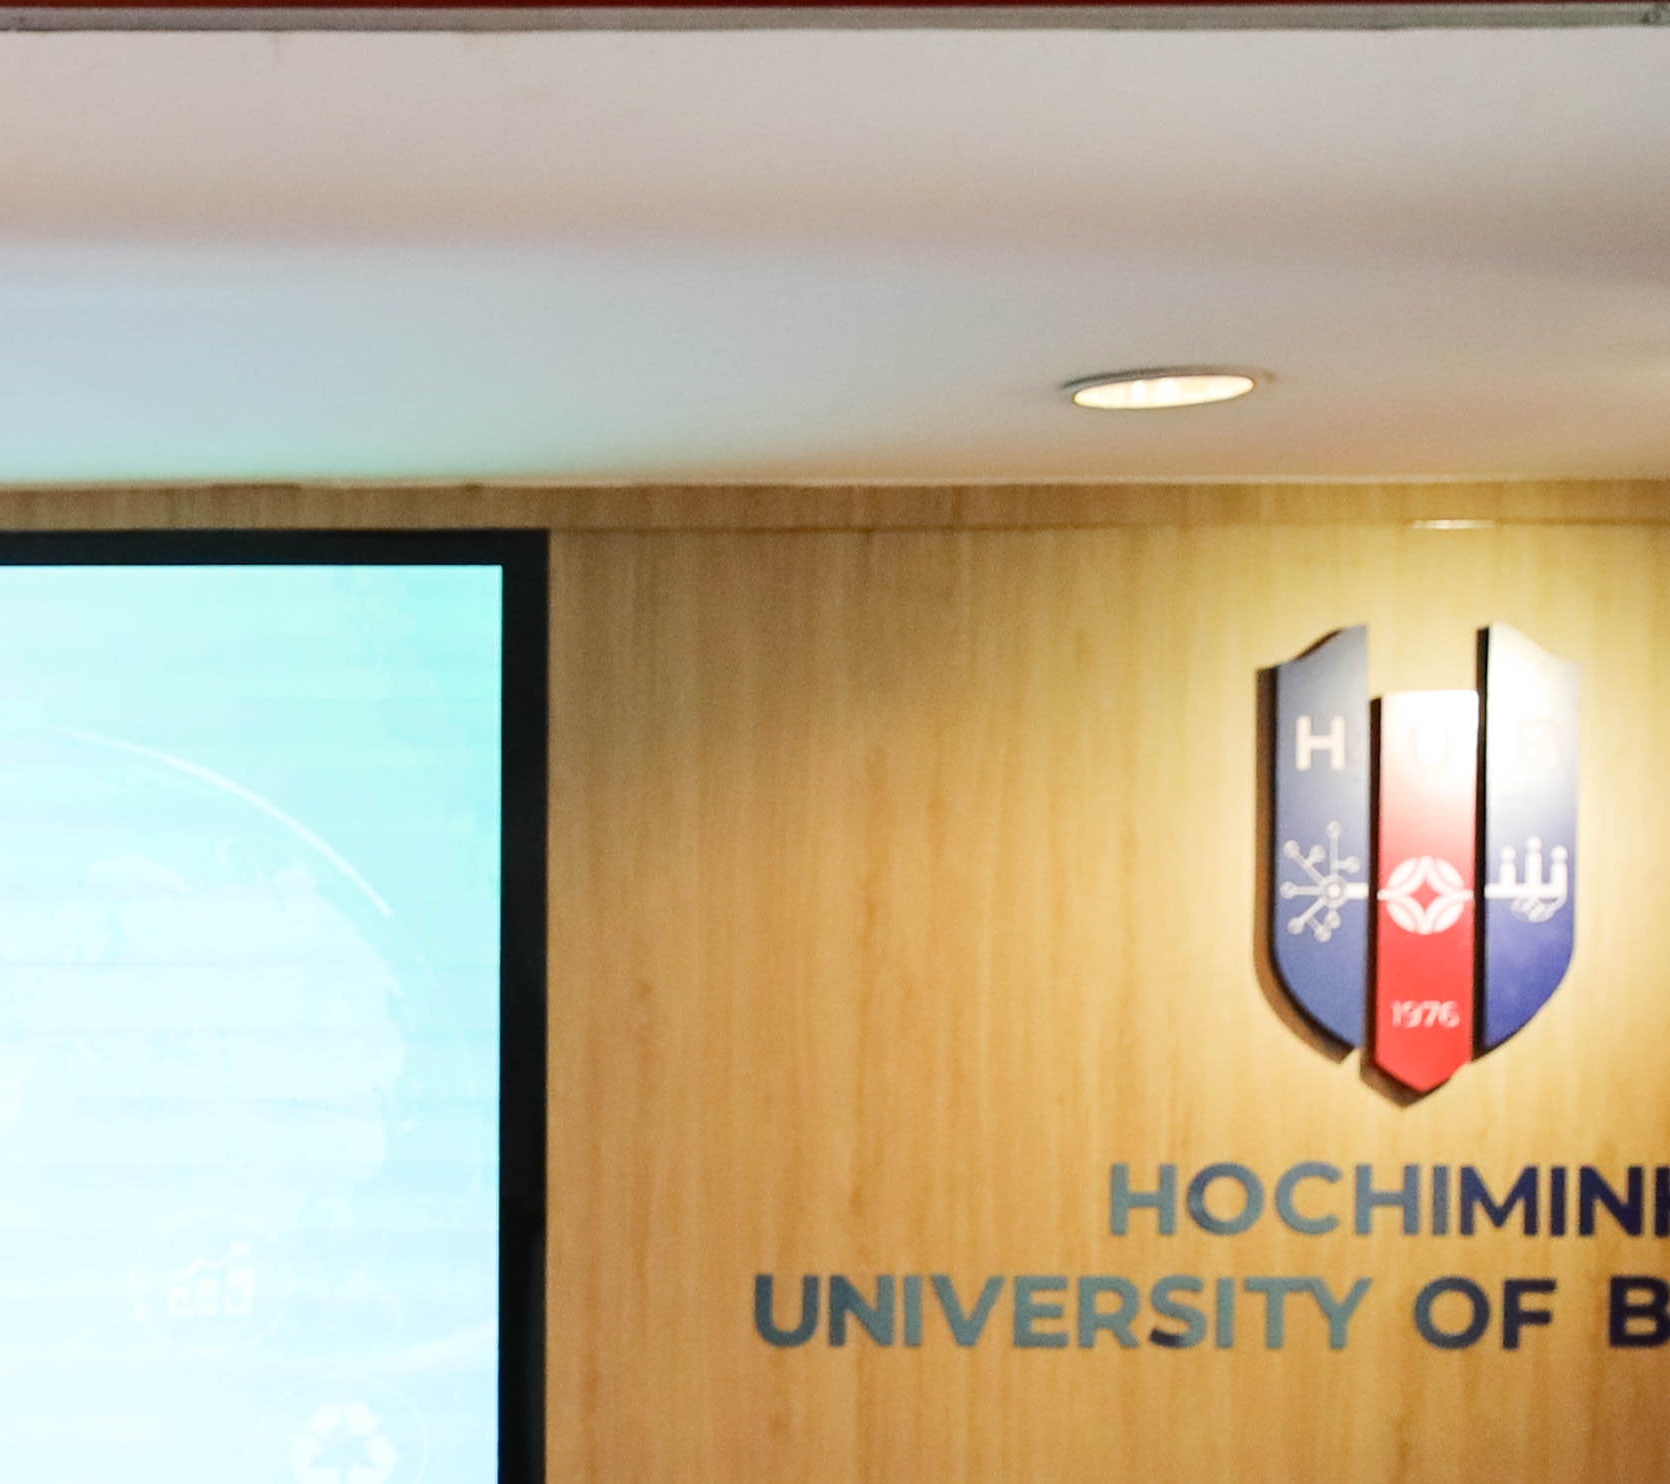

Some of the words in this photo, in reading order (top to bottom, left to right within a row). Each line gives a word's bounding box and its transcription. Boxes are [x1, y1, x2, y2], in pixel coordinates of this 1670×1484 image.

[1392, 1000, 1460, 1029] 1976
[1109, 1163, 1670, 1238] HOCHIMIN
[753, 1273, 1372, 1350] UNIVERSITY
[1414, 1275, 1558, 1350] OF
